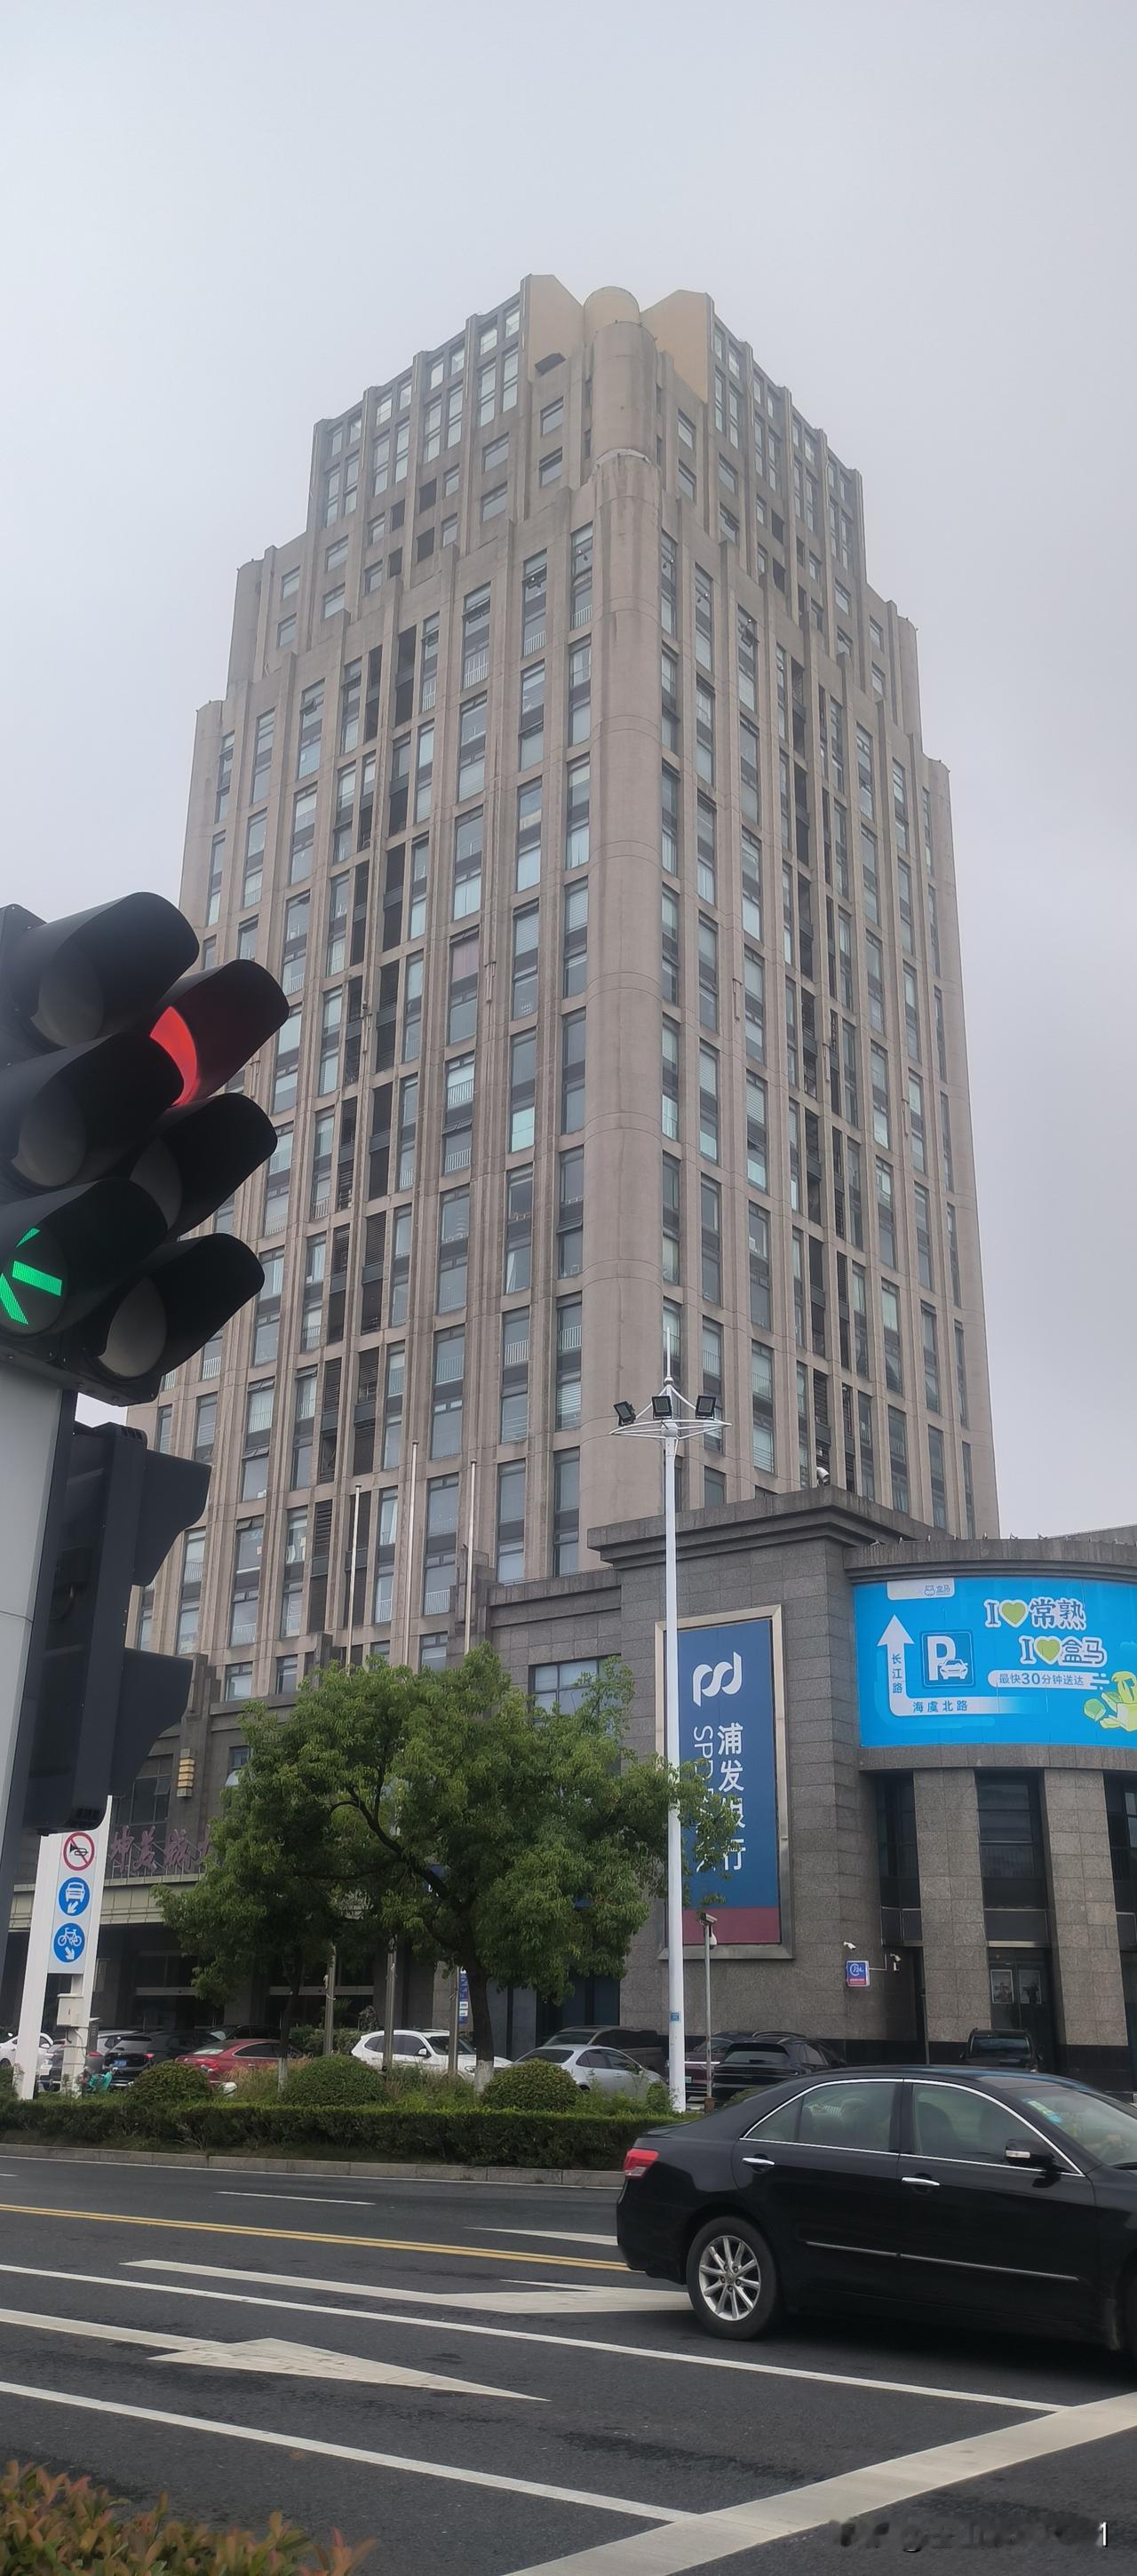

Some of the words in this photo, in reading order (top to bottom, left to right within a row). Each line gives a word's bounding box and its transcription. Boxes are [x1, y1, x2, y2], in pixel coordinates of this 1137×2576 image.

[1030, 1599, 1085, 1628] 常熟
[1061, 1639, 1104, 1665] 盒马
[892, 1653, 902, 1694] 长江路
[999, 1673, 1084, 1686] 最快30分钟送达
[912, 1700, 967, 1713] 海虞北路
